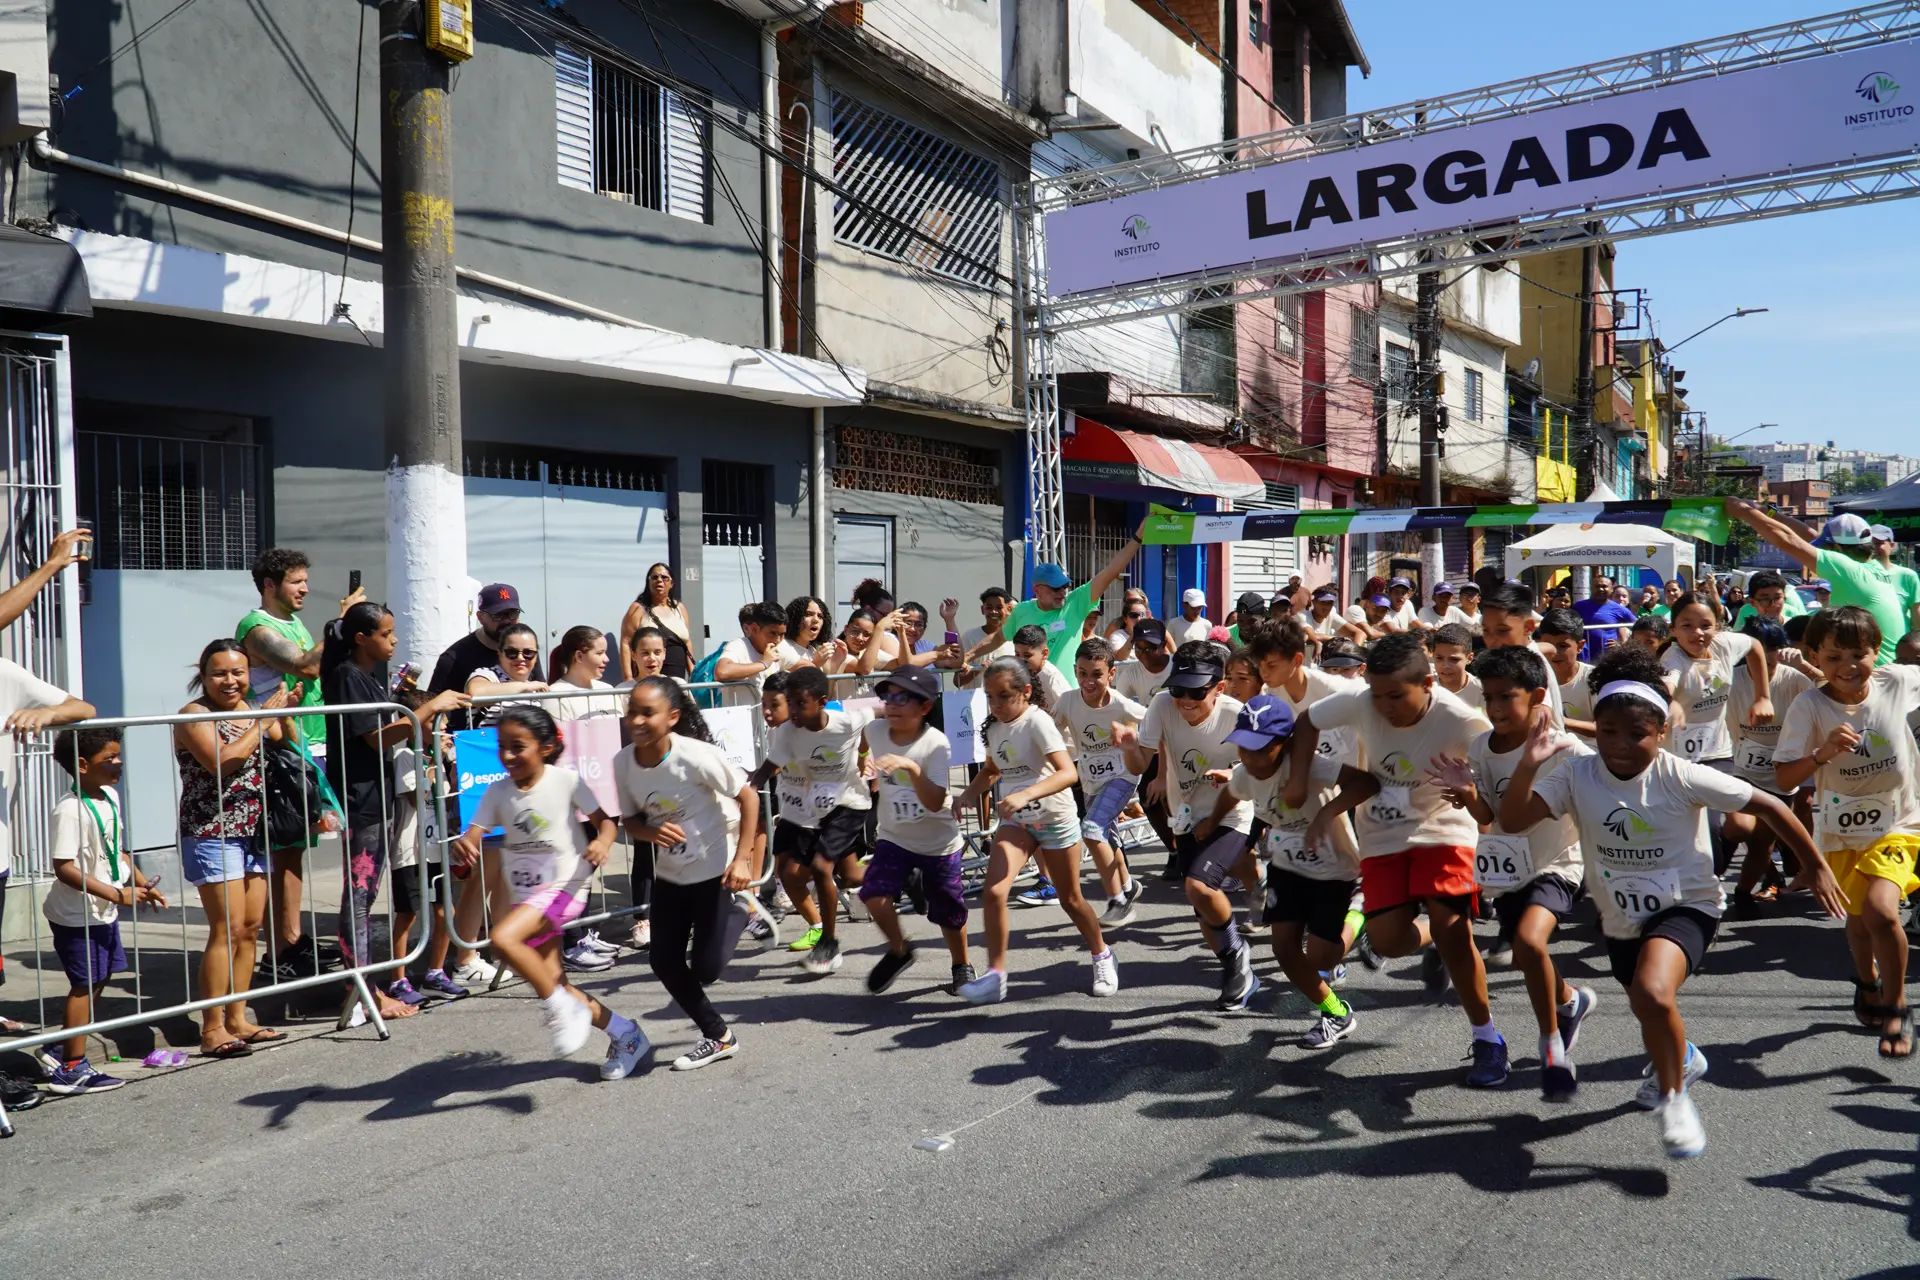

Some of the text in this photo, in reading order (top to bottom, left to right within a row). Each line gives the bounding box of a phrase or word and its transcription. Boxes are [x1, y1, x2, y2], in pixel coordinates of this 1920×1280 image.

[1845, 105, 1914, 126] INSTITUTO
[1246, 107, 1711, 240] LARGADA
[1114, 241, 1160, 257] INSTITUTO
[1205, 520, 1233, 528] INSTITUTO
[1088, 761, 1115, 775] 054
[1839, 756, 1897, 776] INSTITUTO
[1838, 809, 1882, 828] 009
[1284, 849, 1320, 862] 143
[1597, 844, 1664, 860] INSTITUTO
[1476, 854, 1517, 875] 016
[1614, 890, 1661, 912] 010
